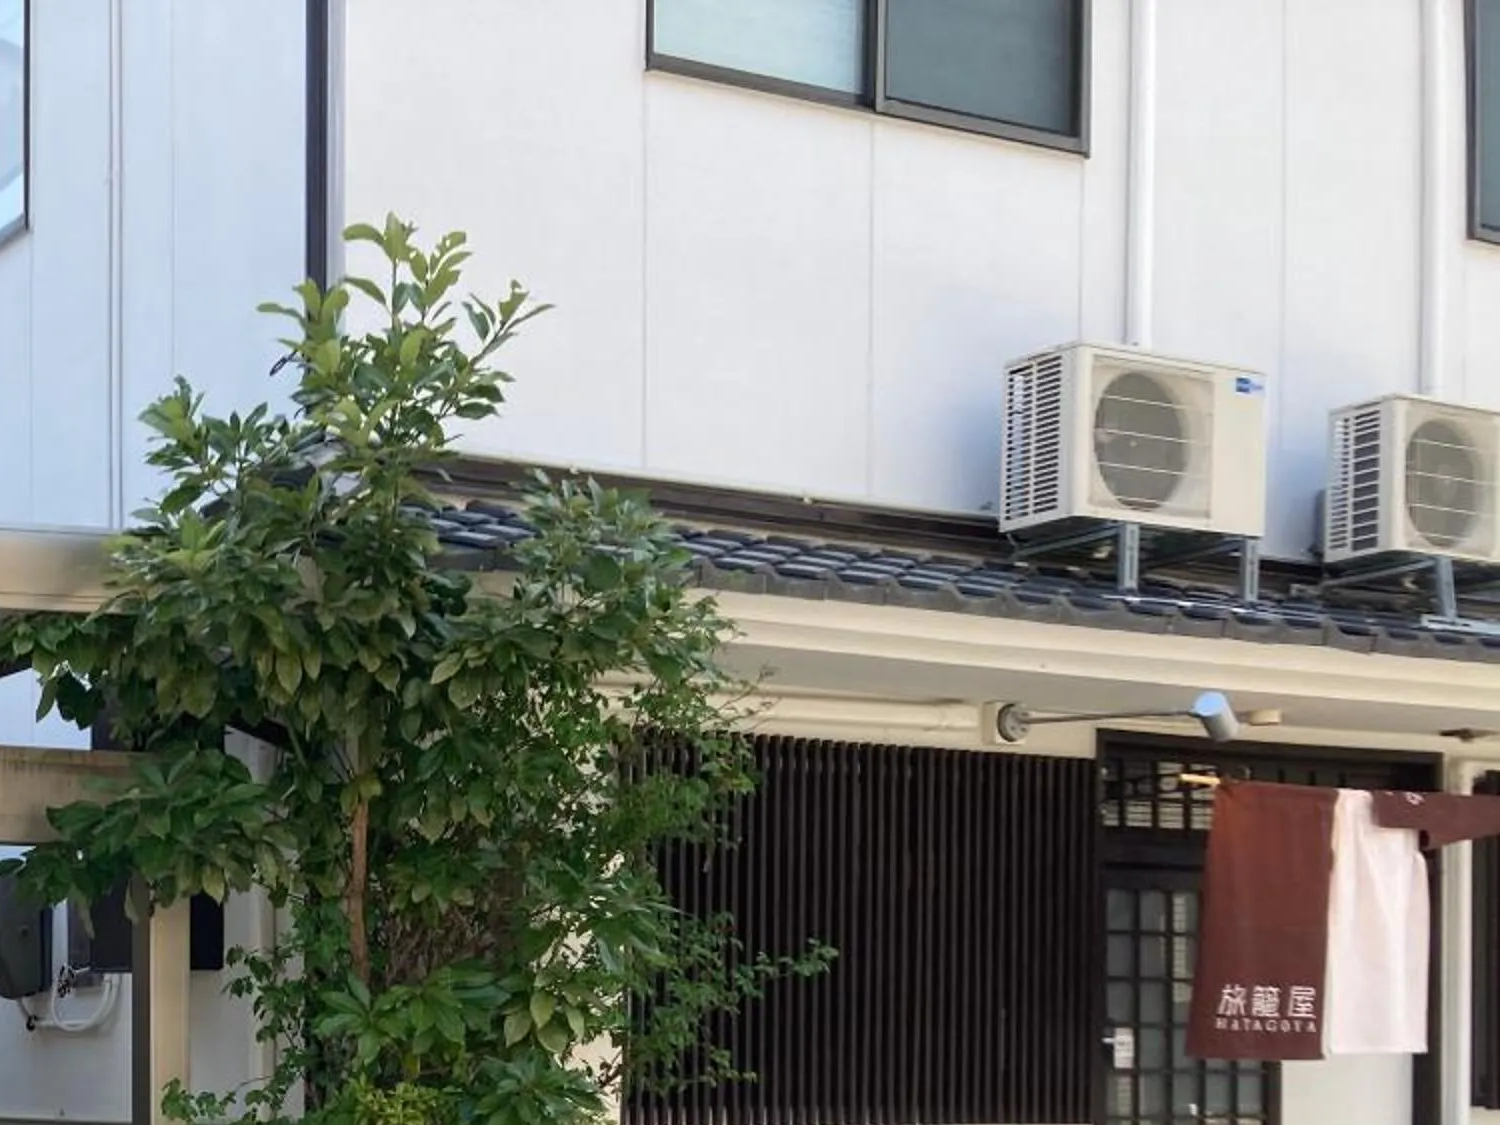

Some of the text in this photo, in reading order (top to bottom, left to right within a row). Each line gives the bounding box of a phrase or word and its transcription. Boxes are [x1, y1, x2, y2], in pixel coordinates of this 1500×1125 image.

[1217, 984, 1317, 1018] 旅籠屋
[1215, 1017, 1317, 1032] HATAGOYA
